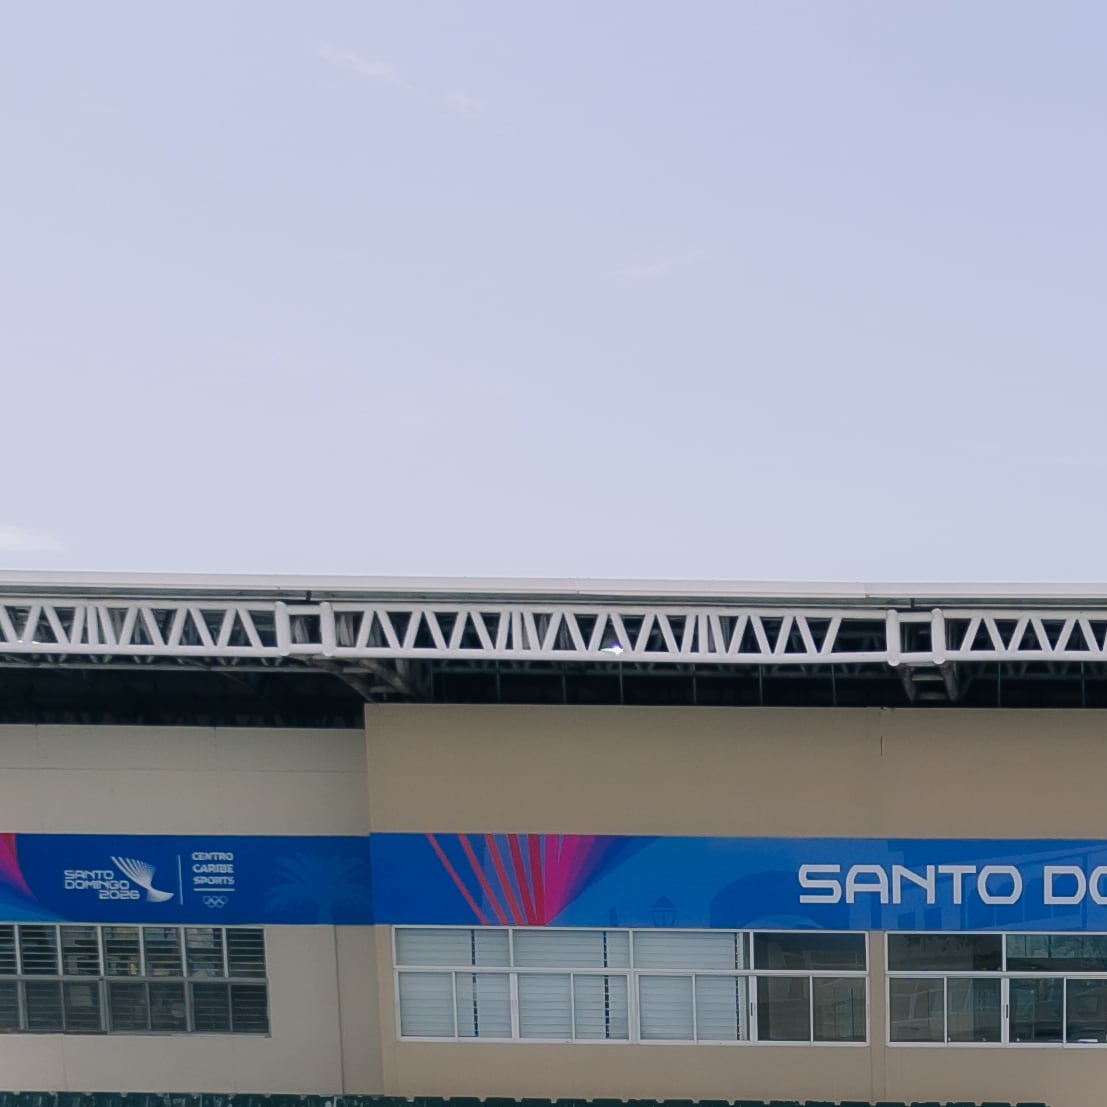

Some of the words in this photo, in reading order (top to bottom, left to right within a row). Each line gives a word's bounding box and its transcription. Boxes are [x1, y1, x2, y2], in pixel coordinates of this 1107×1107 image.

[191, 851, 234, 861] CENTRO
[192, 864, 234, 874] CARIBE
[64, 870, 114, 880] SANTO
[64, 880, 130, 890] DOMINGO
[193, 876, 235, 885] SPORTS
[799, 864, 1022, 905] SANTO
[99, 890, 141, 900] 2026
